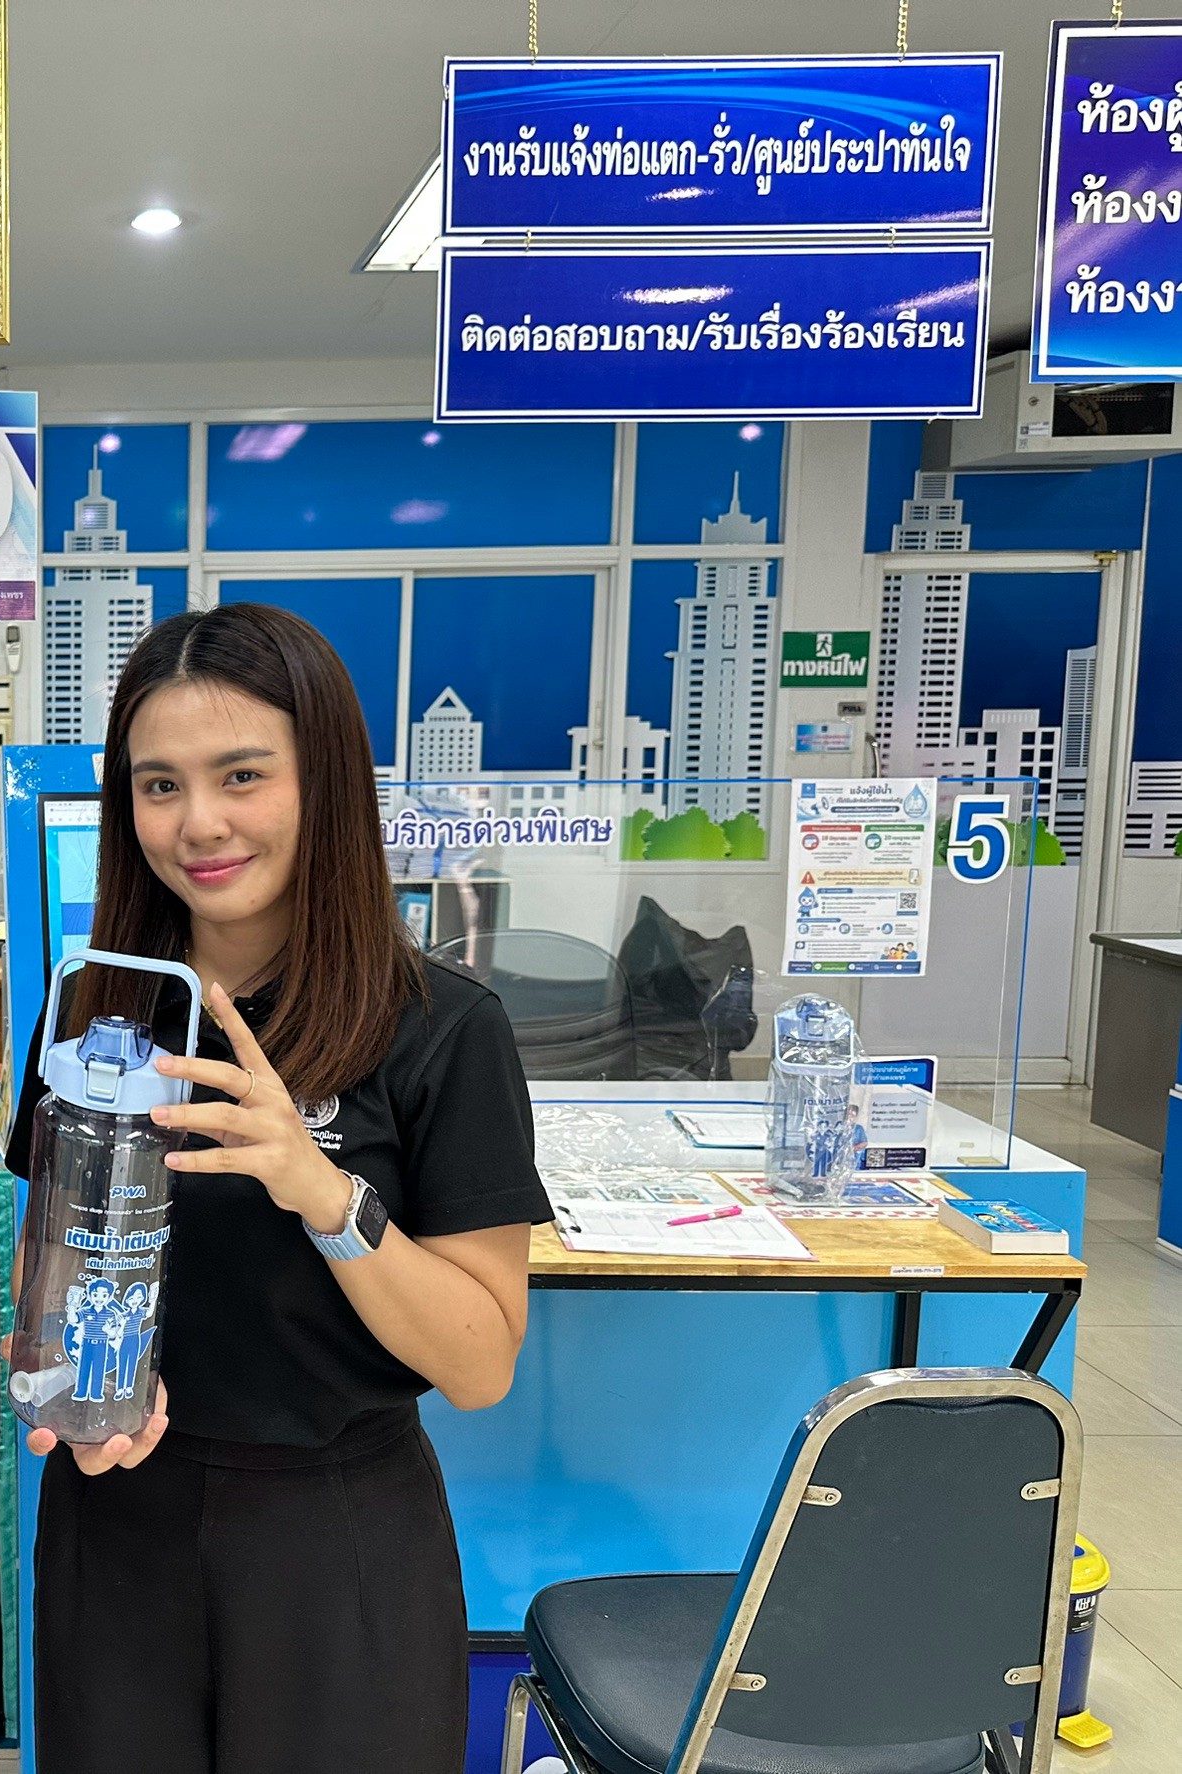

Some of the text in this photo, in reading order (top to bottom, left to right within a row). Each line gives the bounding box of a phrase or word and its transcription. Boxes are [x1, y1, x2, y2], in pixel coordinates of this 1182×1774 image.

[463, 112, 971, 195] งานรับแจ้งท่อแตก-รั่ว/ศูนย์ประปาทันใจ
[461, 303, 965, 352] ติดต่อสอบถาม/รับเรื่องร้องเรียน
[782, 652, 867, 677] ทางหนีไฟ
[849, 783, 892, 797] แจ้งผู้ใช้น้ำ
[381, 808, 612, 846] บริการด่วนพิเศษ
[948, 795, 1010, 884] 5
[308, 1129, 343, 1141] วนภูมิภาค
[110, 1185, 146, 1198] PWA
[65, 1225, 170, 1252] เติมน้ำ เติมสุข
[85, 1253, 156, 1270] เติมโลกให้น่าอยู่
